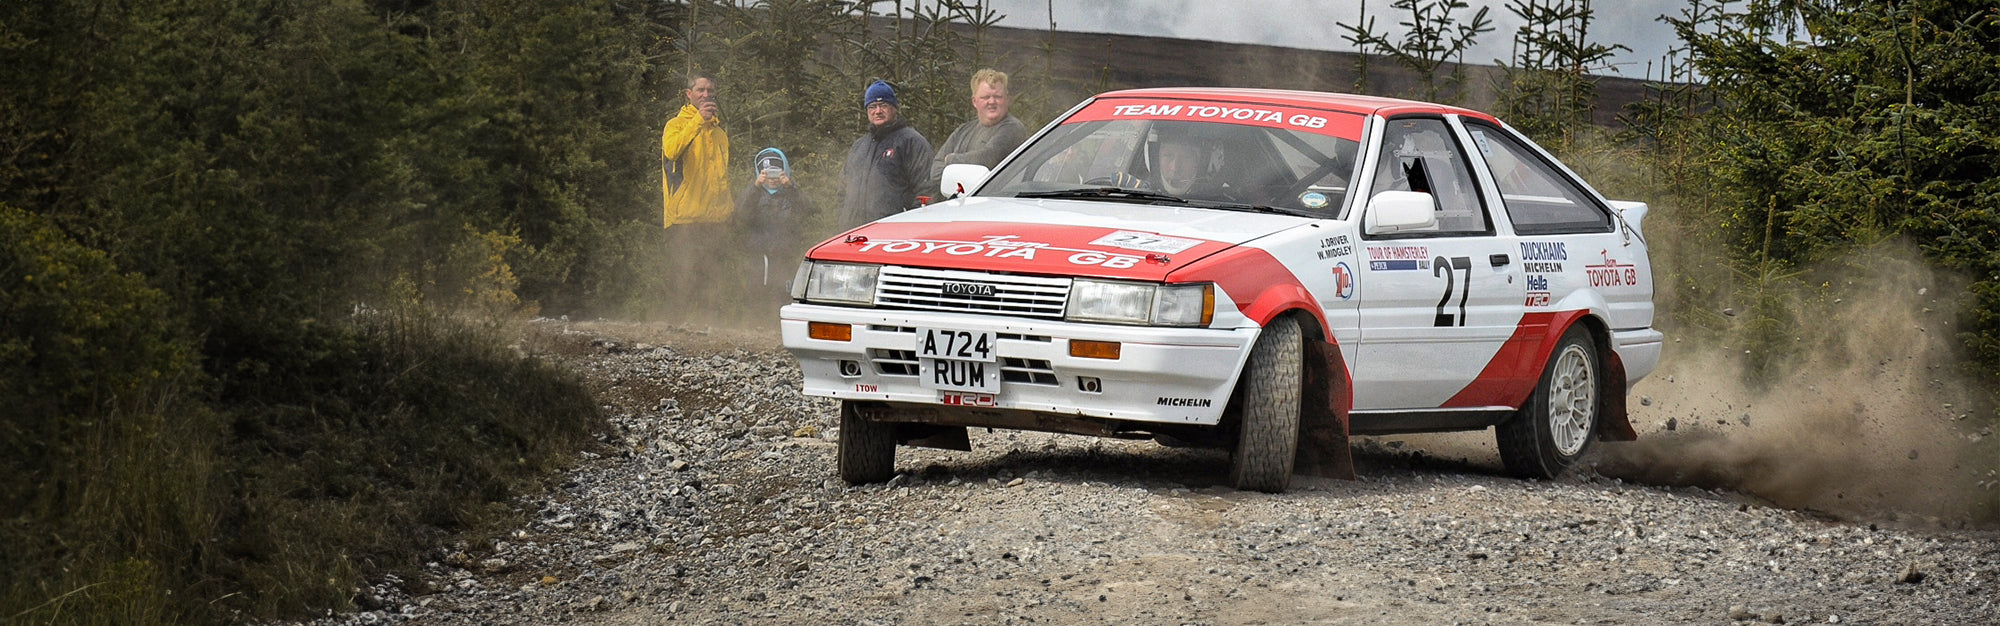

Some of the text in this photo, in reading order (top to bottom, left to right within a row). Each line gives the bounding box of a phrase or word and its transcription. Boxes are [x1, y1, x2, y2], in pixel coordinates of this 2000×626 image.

[1112, 104, 1328, 129] TEAM TOYOTA GB
[857, 241, 1141, 269] TOYOTA GB
[1367, 247, 1429, 259] TOUR OF HAMSTERLEY
[1520, 241, 1567, 260] DUCKHAMS
[1524, 262, 1563, 273] MICHELIN
[1527, 275, 1548, 290] Hella
[1586, 268, 1636, 287] TOYOTA GB
[945, 283, 992, 296] TOYOTA
[1433, 255, 1472, 327] 27
[923, 329, 990, 359] A724
[934, 359, 985, 388] RUM
[944, 391, 995, 407] TRD
[1156, 396, 1212, 408] MICHELIN
